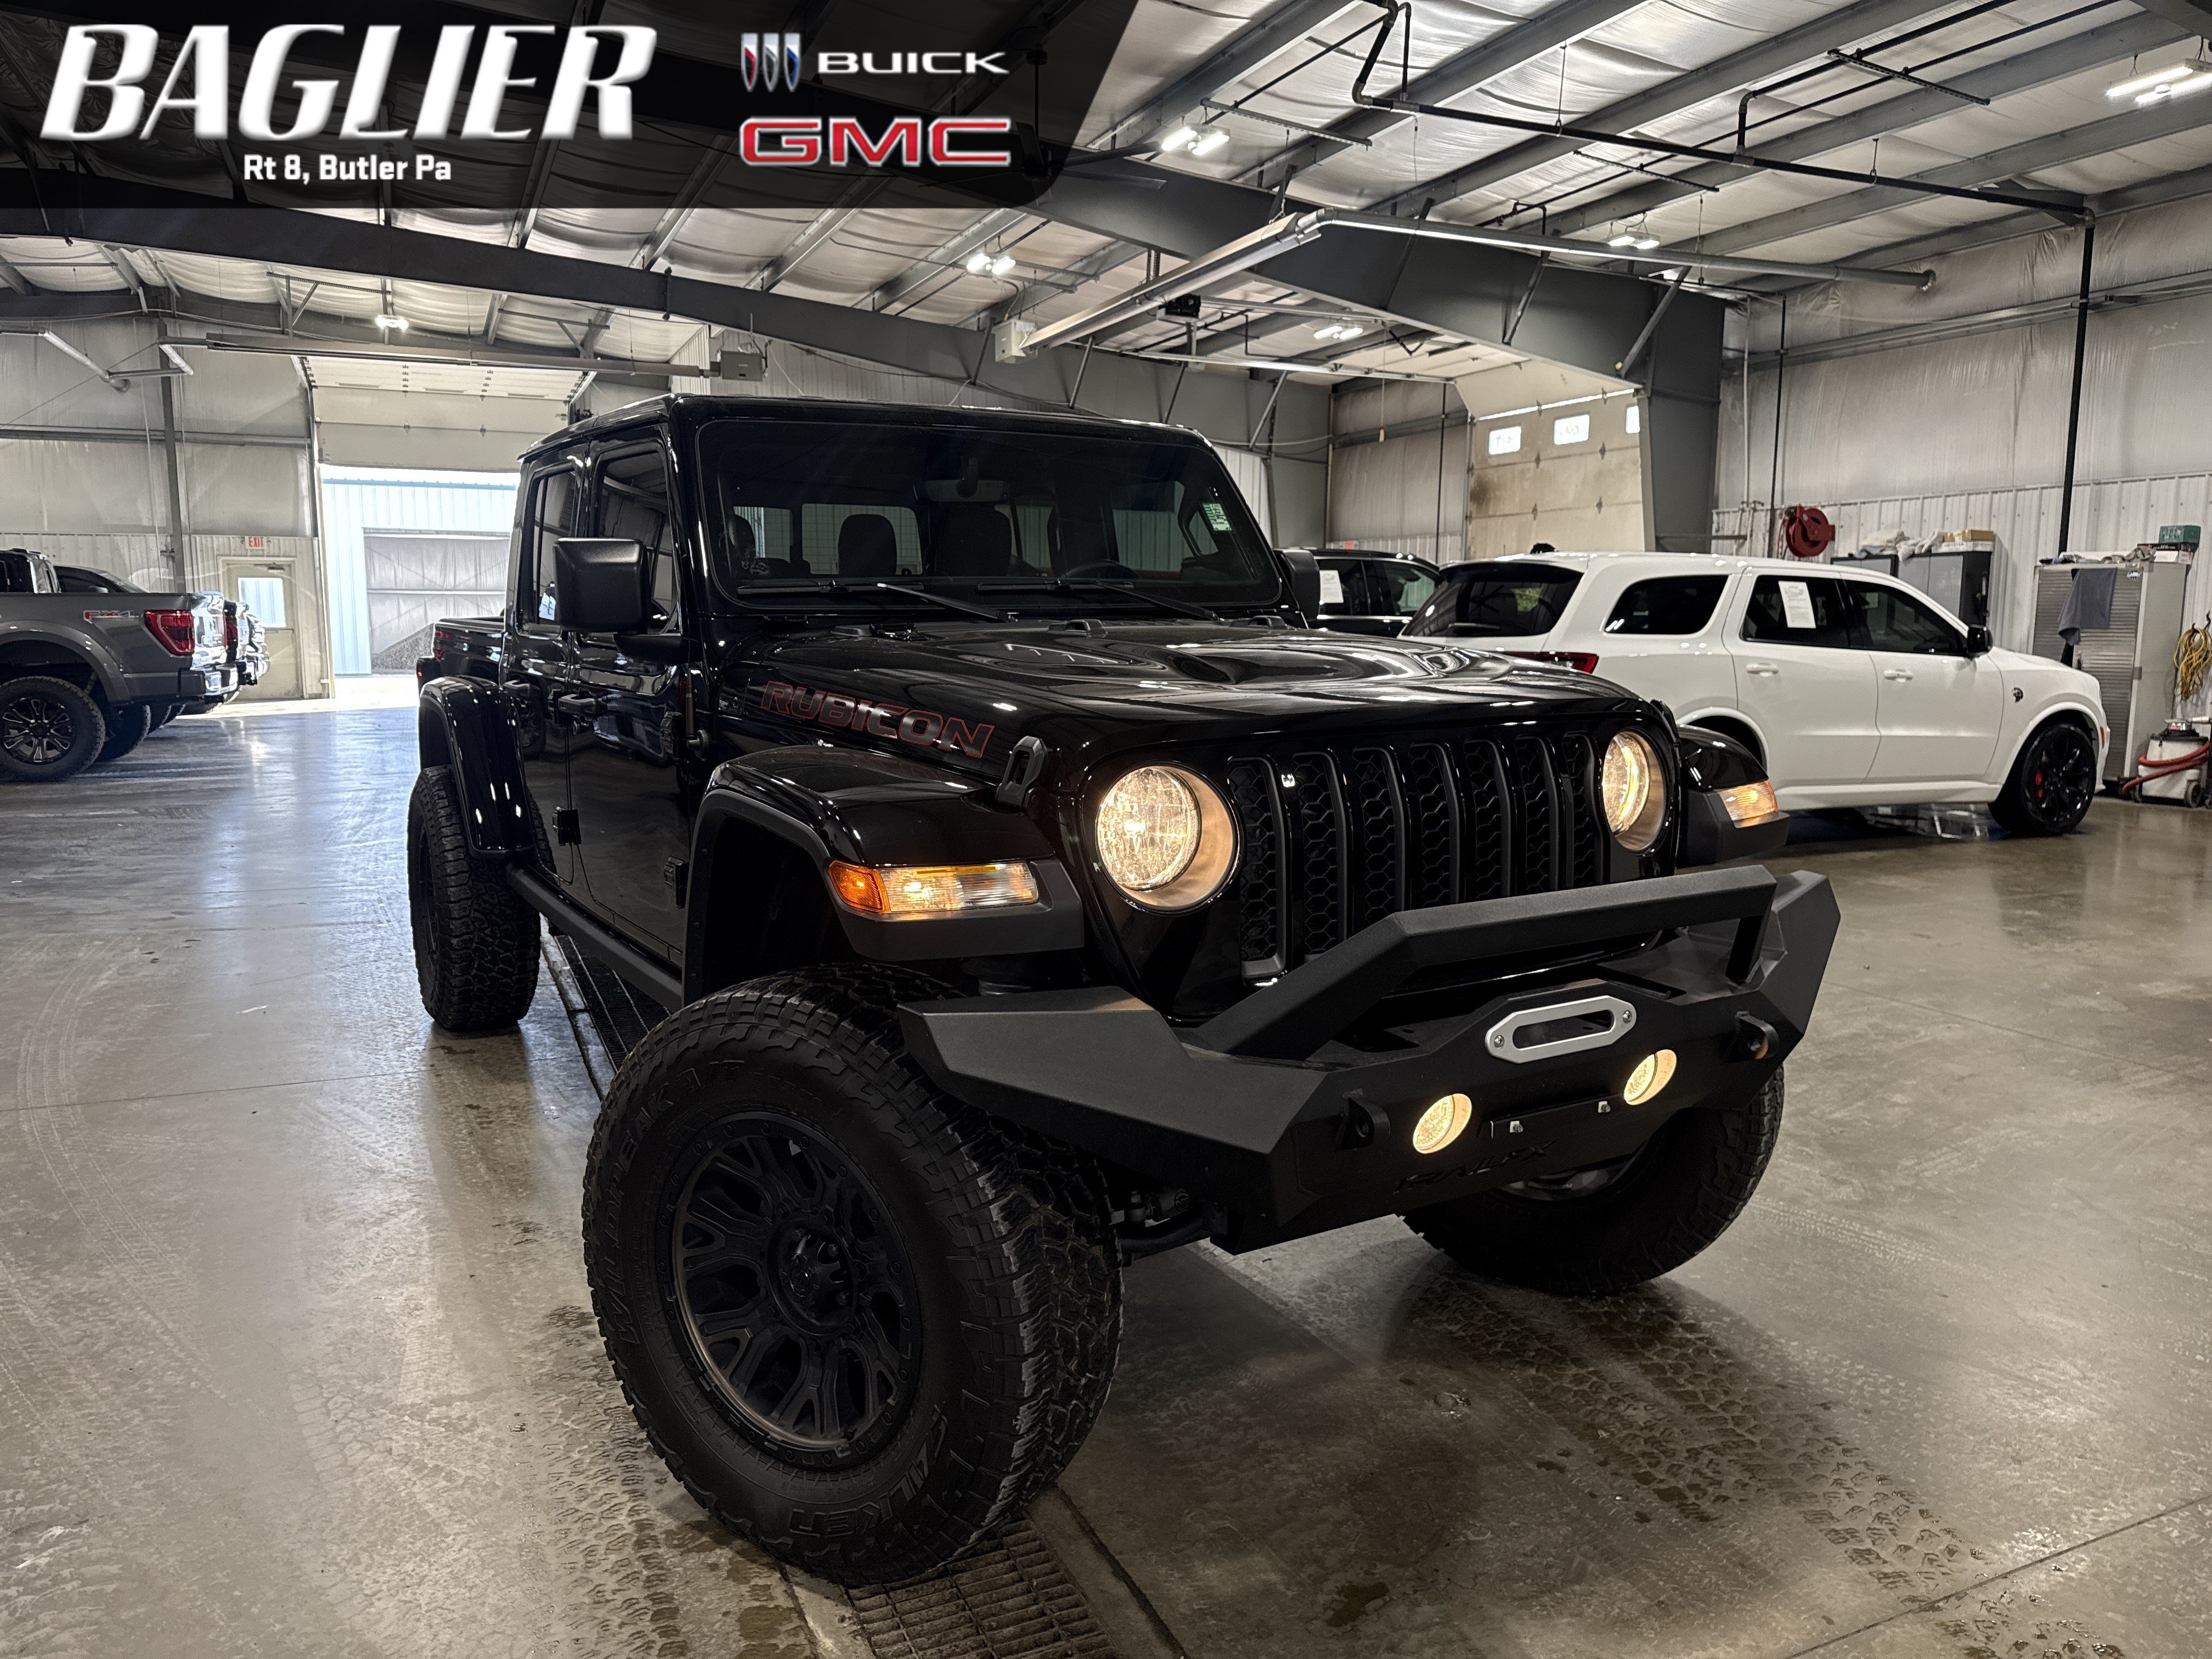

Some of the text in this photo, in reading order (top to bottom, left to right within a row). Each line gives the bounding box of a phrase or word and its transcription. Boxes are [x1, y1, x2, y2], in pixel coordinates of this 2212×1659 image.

[249, 537, 263, 548] EXIT
[83, 610, 139, 624] FX4
[760, 681, 995, 759] RUBICON
